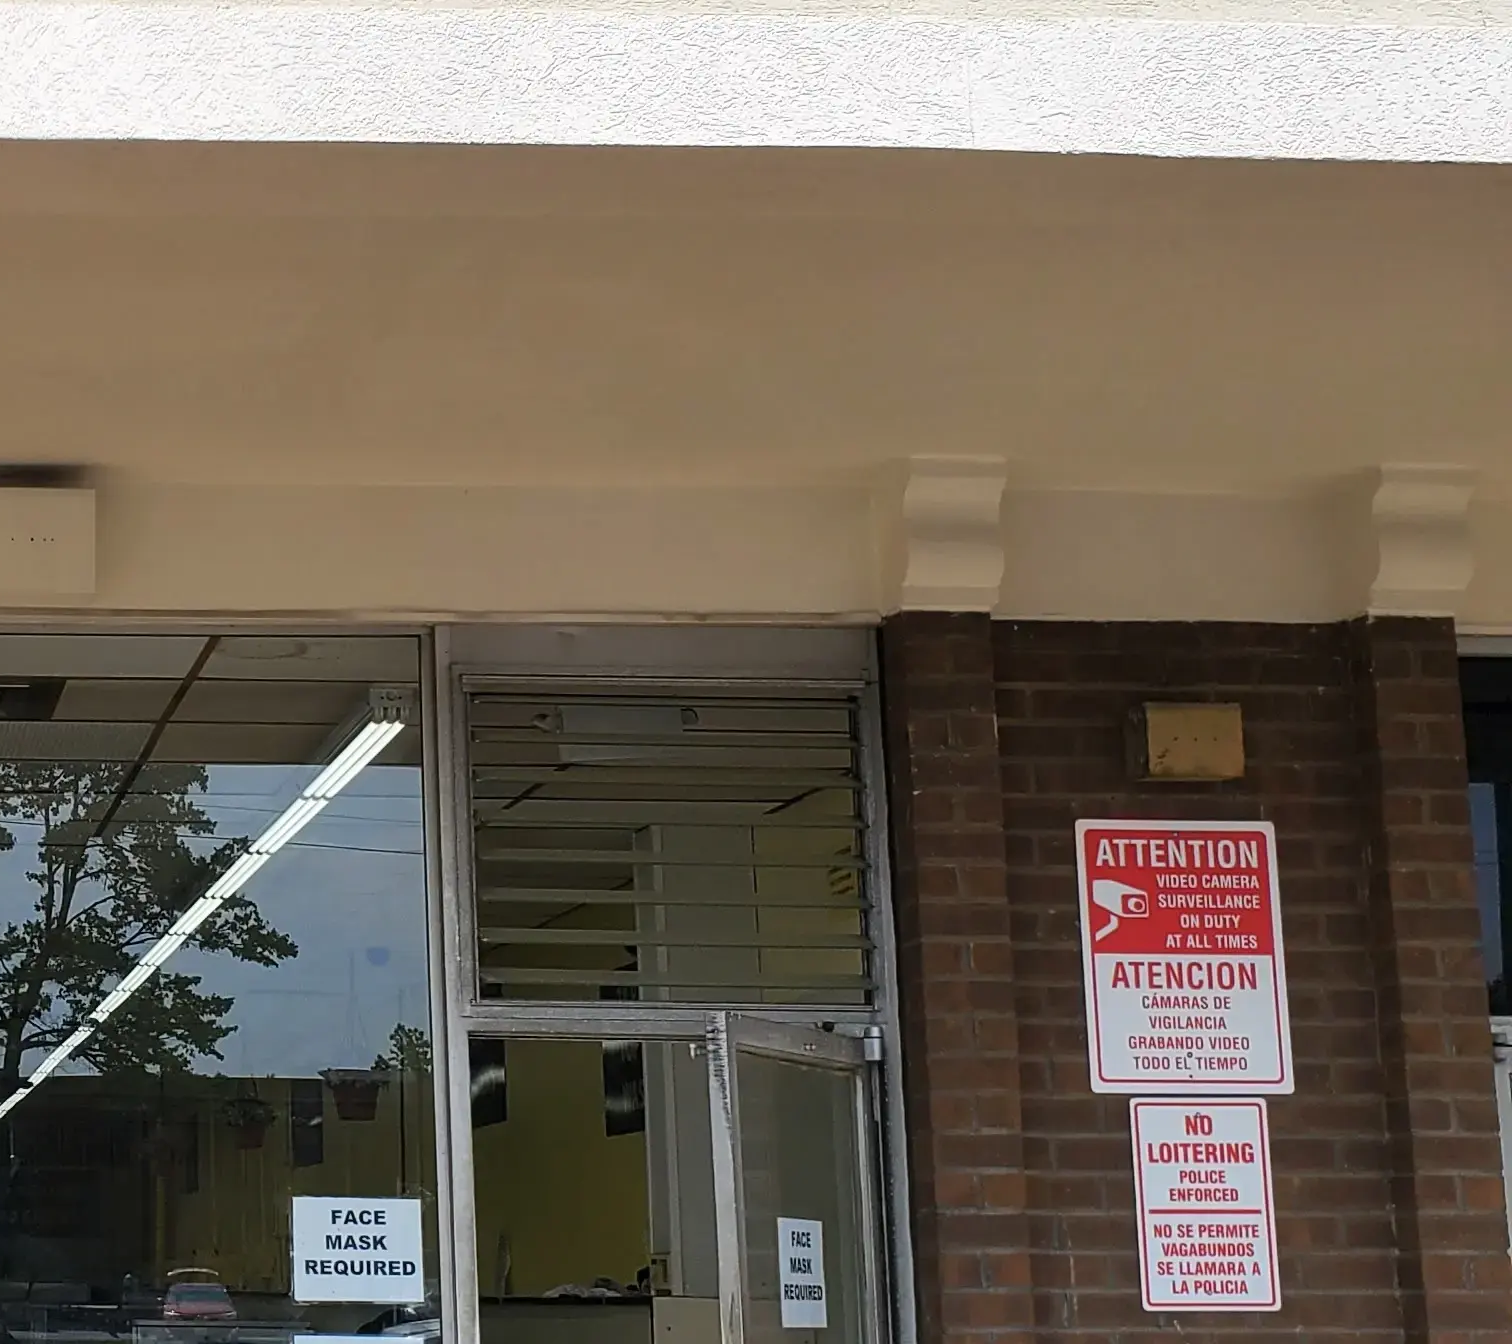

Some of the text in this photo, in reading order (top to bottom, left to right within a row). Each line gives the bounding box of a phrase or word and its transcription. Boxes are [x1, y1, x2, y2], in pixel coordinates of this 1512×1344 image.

[1095, 838, 1259, 869] ATTENTION
[1156, 874, 1260, 889] VIDEO CAMERA
[1157, 894, 1261, 909] SURVEILLANCE
[1180, 914, 1240, 929] ON DUTY
[1166, 934, 1258, 949] AT ALL TIMES
[1111, 961, 1258, 990] ATENCION
[1142, 992, 1231, 1010] CÁMARAS DE
[1148, 1016, 1227, 1030] VIGILANCIA
[1128, 1036, 1250, 1051] GRABANDO VIDEO
[1133, 1056, 1248, 1071] TODO EL TIEMPO
[1184, 1115, 1213, 1136] NO
[1147, 1143, 1255, 1164] LOITERING
[1179, 1170, 1226, 1184] POLICE
[1169, 1188, 1239, 1202] ENFORCED
[331, 1210, 387, 1225] FACE
[1153, 1224, 1260, 1239] NO SE PERMITE
[325, 1235, 388, 1251] MASK
[791, 1231, 811, 1249] FACE
[1161, 1243, 1255, 1257] VAGABUNDOS
[304, 1259, 416, 1277] REQUIRED
[790, 1257, 813, 1275] MASK
[1157, 1261, 1261, 1276] SE LLAMARA A
[784, 1283, 823, 1301] REQUIRED
[1172, 1280, 1249, 1295] LA POLICIA
